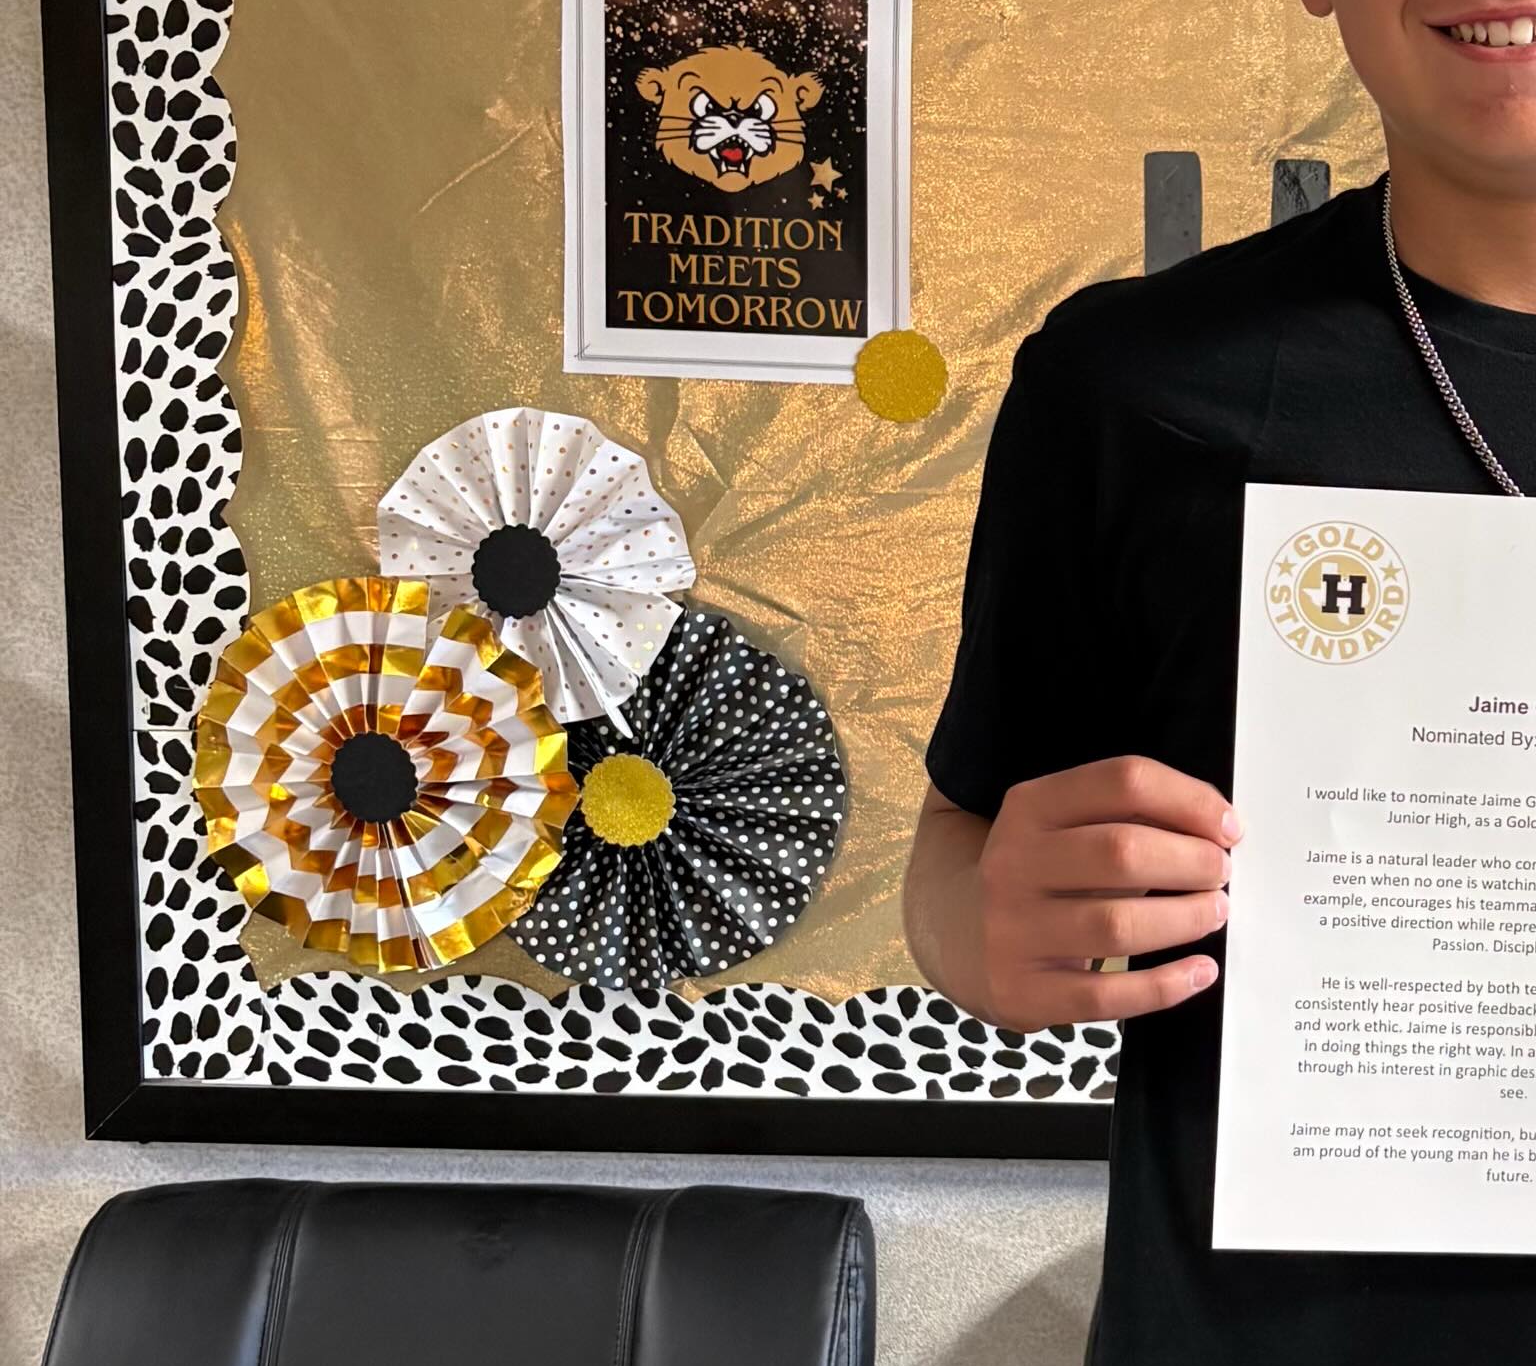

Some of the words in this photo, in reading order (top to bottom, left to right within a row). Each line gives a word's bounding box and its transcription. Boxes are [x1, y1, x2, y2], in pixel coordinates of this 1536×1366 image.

[623, 212, 843, 252] TRADITION
[669, 253, 801, 288] MEETS
[617, 291, 864, 330] TOMORROW
[1293, 525, 1385, 562] GOLD
[1321, 573, 1368, 615] H
[1270, 584, 1405, 660] STANDARD
[1468, 695, 1530, 715] Jaime
[1411, 726, 1506, 746] Nominated
[1306, 786, 1311, 799] I
[1314, 787, 1359, 801] would
[1362, 787, 1387, 803] like
[1390, 790, 1406, 803] to
[1409, 790, 1478, 806] nominate
[1479, 793, 1522, 808] Jaime
[1386, 810, 1432, 825] Junior
[1434, 812, 1471, 829] High,
[1474, 816, 1491, 828] as
[1493, 817, 1503, 828] a
[1305, 850, 1348, 864] Jaime
[1351, 850, 1362, 865] is
[1365, 854, 1374, 865] a
[1378, 852, 1429, 867] natural
[1432, 853, 1478, 869] leader
[1480, 855, 1512, 870] who
[1332, 874, 1367, 885] even
[1370, 872, 1410, 887] when
[1414, 877, 1433, 888] no
[1435, 877, 1463, 889] one
[1466, 875, 1478, 890] is
[1303, 893, 1367, 909] example,
[1370, 896, 1452, 912] encourages
[1455, 896, 1476, 911] his
[1319, 916, 1328, 926] a
[1331, 914, 1387, 929] positive
[1390, 915, 1454, 930] direction
[1457, 917, 1495, 932] while
[1432, 937, 1489, 952] Passion.
[1321, 976, 1341, 990] He
[1344, 976, 1356, 990] is
[1358, 977, 1463, 995] well-respected
[1466, 979, 1484, 997] by
[1487, 980, 1521, 995] both
[1294, 996, 1379, 1015] consistently
[1382, 998, 1415, 1013] hear
[1418, 1000, 1474, 1016] positive
[1294, 1017, 1321, 1031] and
[1325, 1018, 1361, 1032] work
[1363, 1018, 1403, 1034] ethic.
[1406, 1020, 1447, 1035] Jaime
[1451, 1021, 1462, 1035] is
[1304, 1038, 1318, 1052] in
[1321, 1038, 1361, 1056] doing
[1364, 1039, 1408, 1058] things
[1411, 1041, 1435, 1056] the
[1439, 1042, 1471, 1059] right
[1475, 1046, 1506, 1060] way.
[1510, 1044, 1524, 1058] In
[1298, 1059, 1354, 1077] through
[1357, 1060, 1378, 1075] his
[1381, 1061, 1435, 1076] interest
[1438, 1063, 1452, 1076] in
[1455, 1063, 1508, 1081] graphic
[1499, 1088, 1528, 1100] see.
[1289, 1122, 1331, 1137] Jaime
[1335, 1126, 1365, 1140] may
[1368, 1126, 1392, 1138] not
[1395, 1125, 1428, 1139] seek
[1432, 1126, 1515, 1143] recognition,
[1292, 1146, 1315, 1157] am
[1319, 1145, 1361, 1160] proud
[1365, 1144, 1381, 1159] of
[1383, 1145, 1407, 1160] the
[1410, 1149, 1454, 1163] young
[1457, 1150, 1488, 1161] man
[1492, 1147, 1510, 1162] he
[1513, 1148, 1525, 1162] is
[1486, 1167, 1533, 1183] future.
